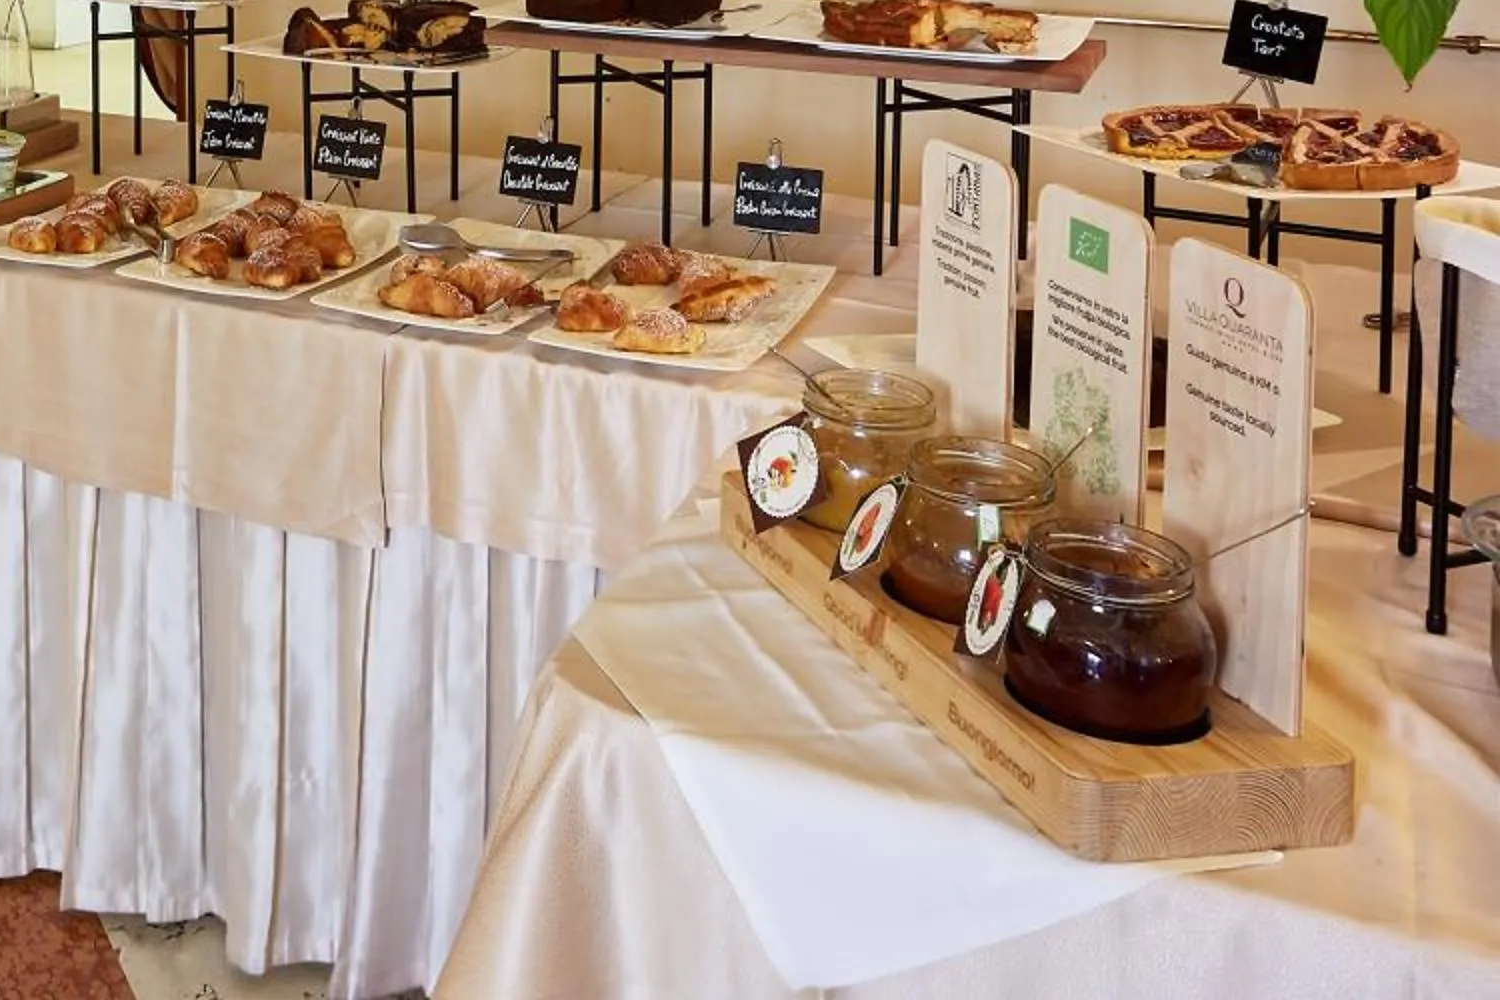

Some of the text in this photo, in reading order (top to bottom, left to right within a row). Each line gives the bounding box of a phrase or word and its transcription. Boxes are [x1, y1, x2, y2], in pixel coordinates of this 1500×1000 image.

[1250, 13, 1305, 41] Crostata
[1252, 38, 1287, 57] Tart
[318, 145, 342, 165] Plain
[1223, 277, 1246, 318] Q
[1185, 344, 1211, 363] Gusto
[1185, 383, 1221, 409] Genuine
[1245, 410, 1275, 438] locally
[947, 698, 1035, 794] Buongiorno!
